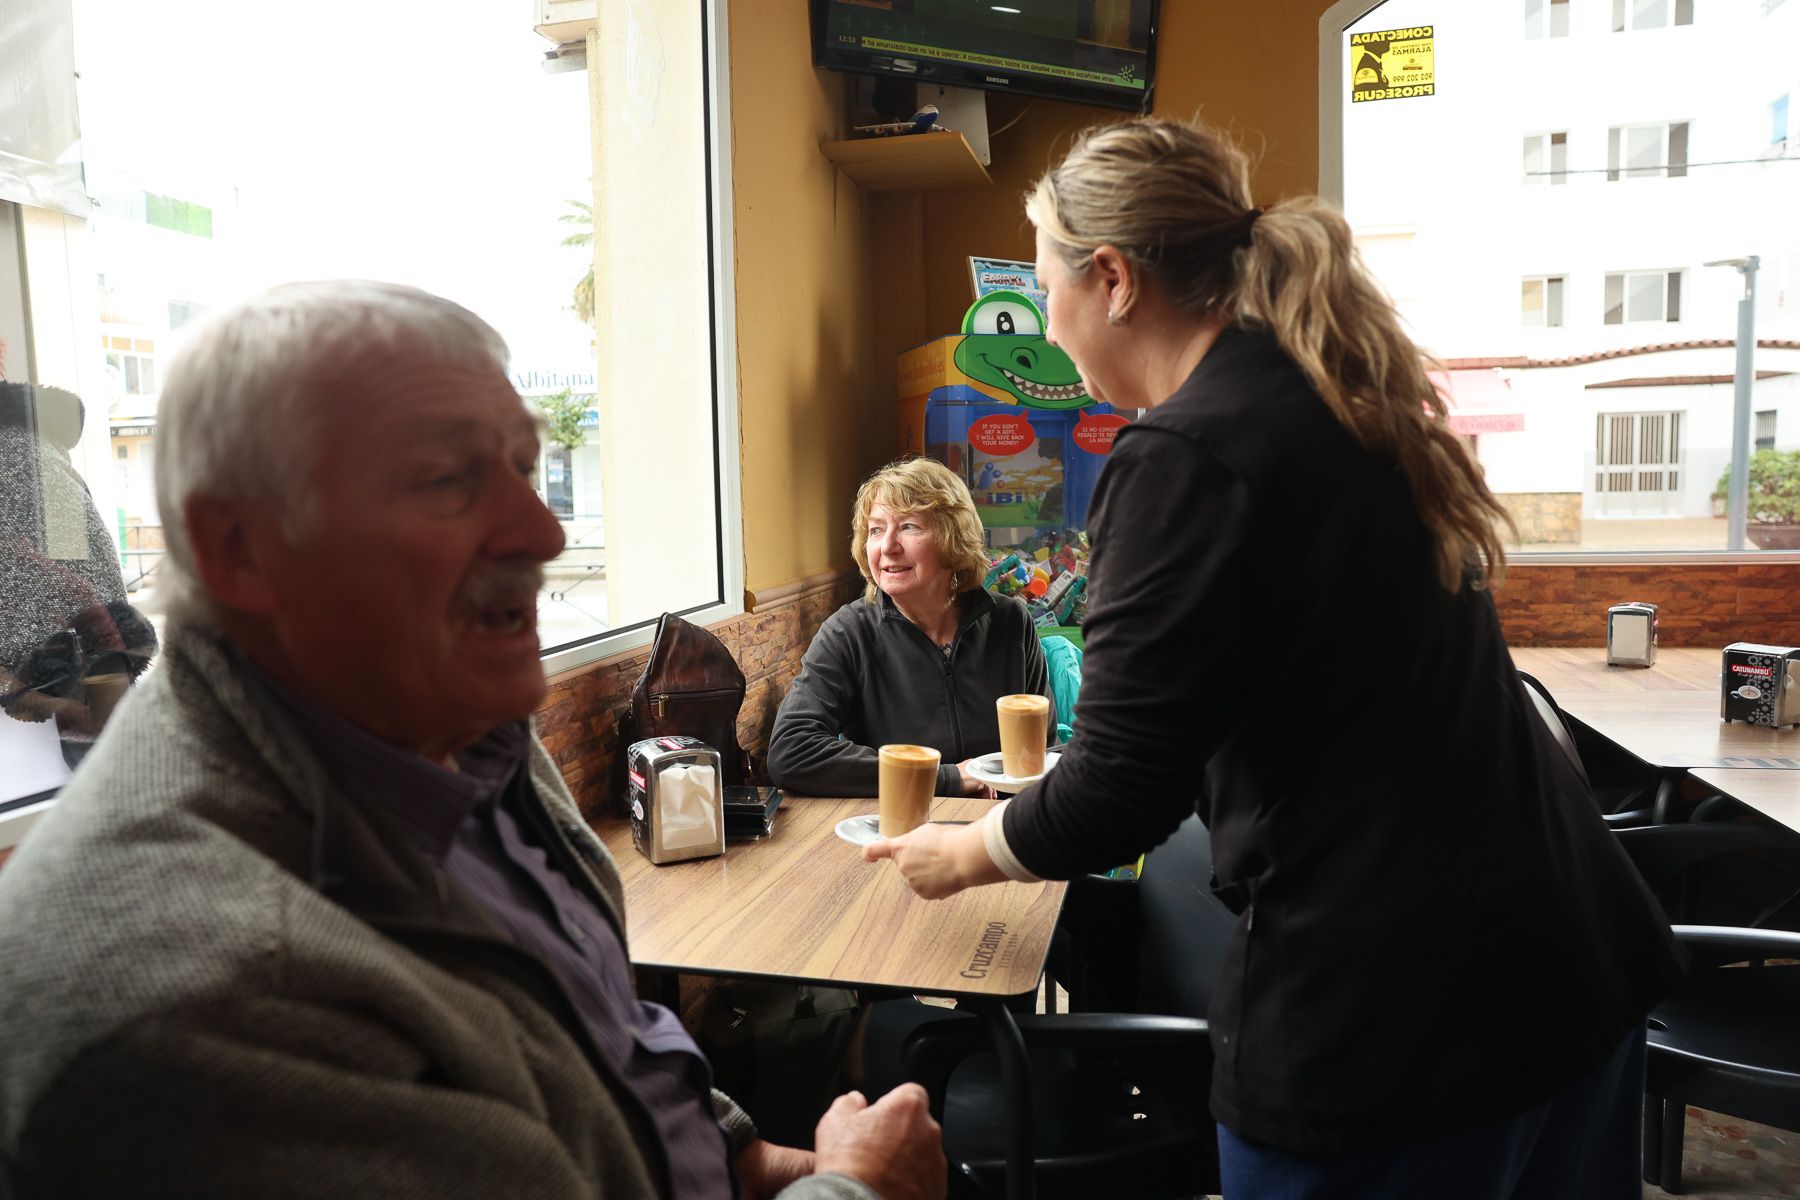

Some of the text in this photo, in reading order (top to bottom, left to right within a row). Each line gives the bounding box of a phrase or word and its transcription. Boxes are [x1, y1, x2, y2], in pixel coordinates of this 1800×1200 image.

[867, 39, 875, 47] ha
[876, 41, 907, 51] anunciado
[908, 45, 919, 54] que
[920, 46, 927, 54] no
[962, 53, 968, 61] A
[1004, 60, 1021, 69] todos
[1022, 62, 1030, 70] los
[986, 76, 1009, 85] SAMSUNG
[959, 921, 1009, 979] Cruzcampo
